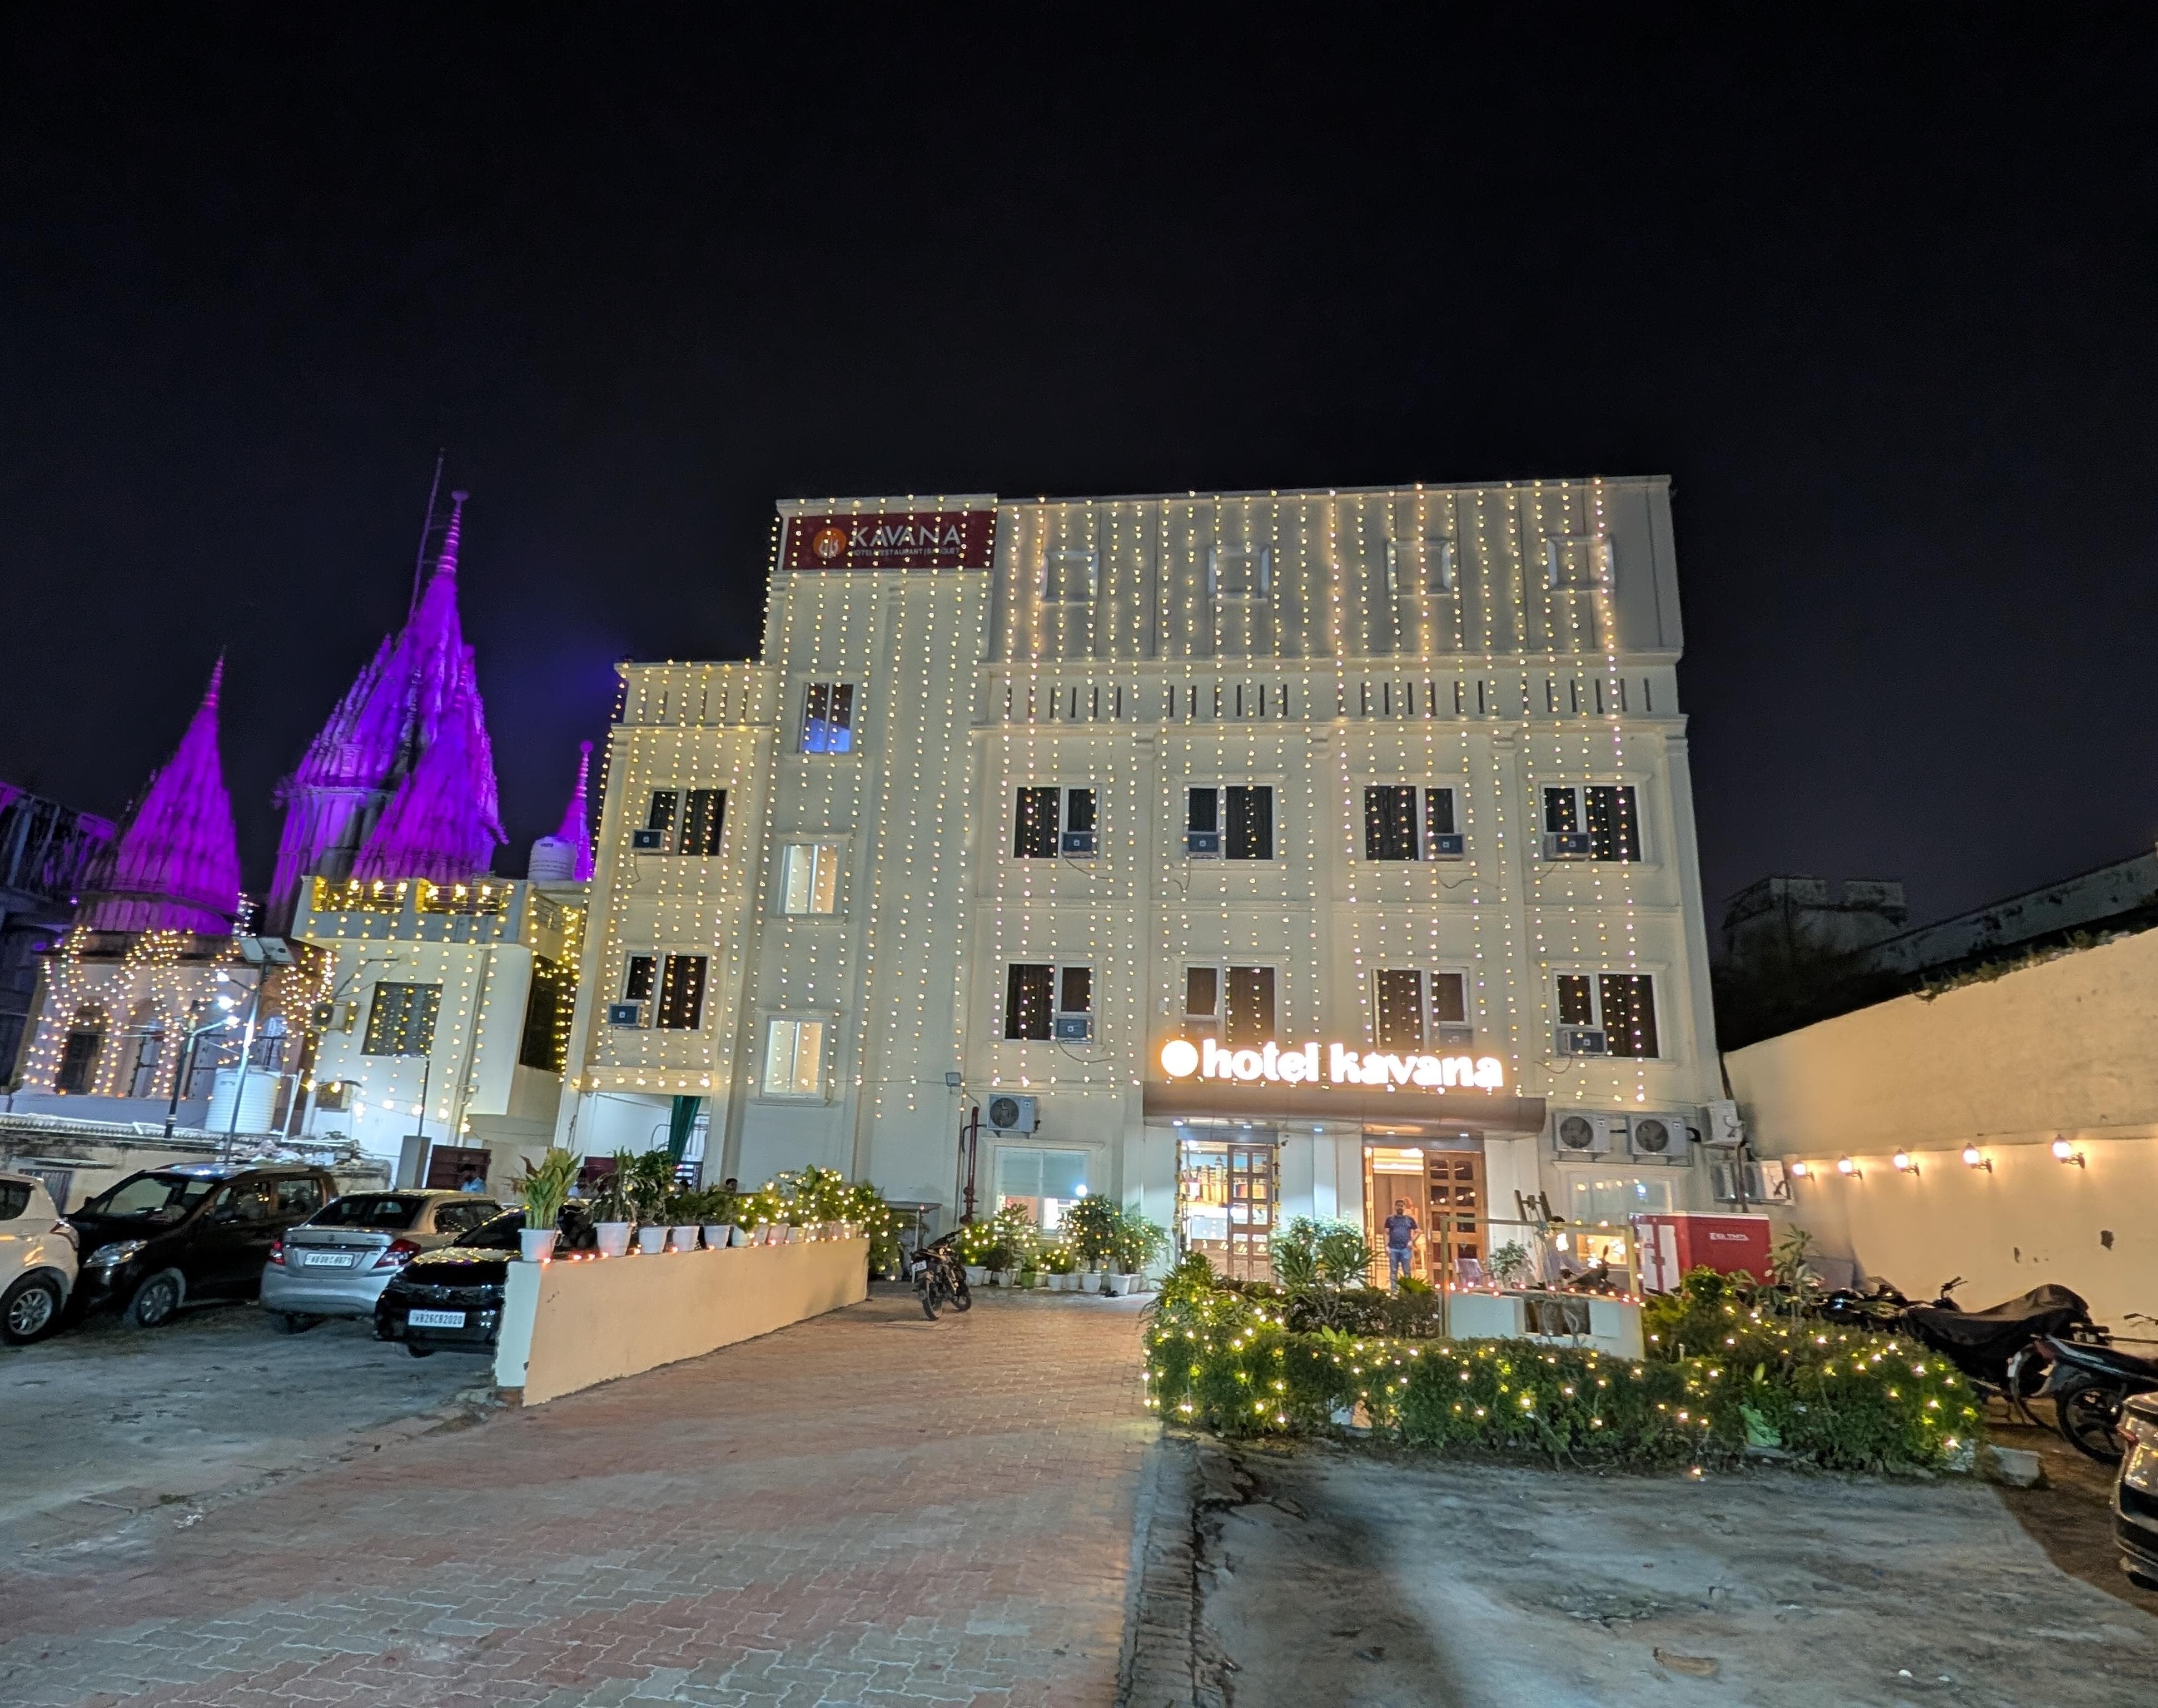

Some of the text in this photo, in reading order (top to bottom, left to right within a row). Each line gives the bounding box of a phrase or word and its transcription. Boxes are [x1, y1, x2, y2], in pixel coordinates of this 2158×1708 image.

[852, 525, 960, 547] KAVANA
[877, 548, 923, 557] ESTAURANT
[1202, 1038, 1503, 1087] hotel kavana
